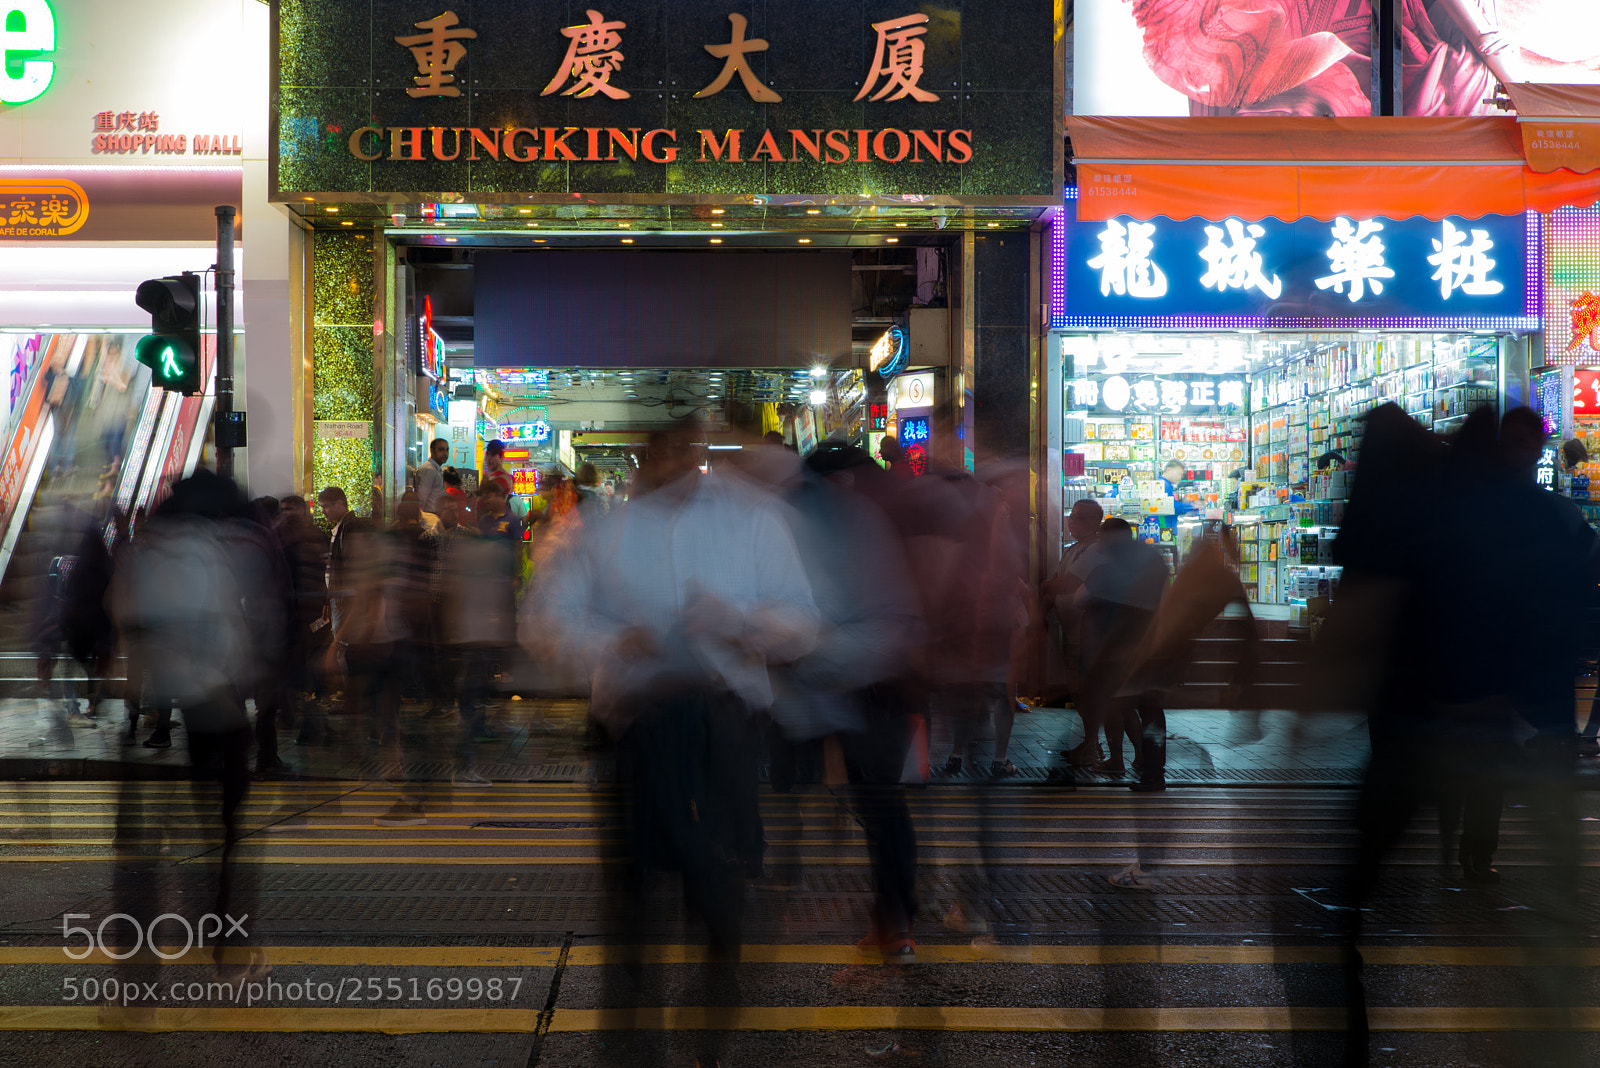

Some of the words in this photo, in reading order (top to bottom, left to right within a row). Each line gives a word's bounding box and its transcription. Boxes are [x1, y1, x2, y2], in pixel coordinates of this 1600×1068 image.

[97, 110, 159, 130] 重庆站
[95, 134, 187, 151] SHOPPING
[194, 134, 243, 151] MALL
[350, 126, 680, 163] CHUNGKING
[697, 127, 973, 163] MANSIONS
[1088, 186, 1137, 197] 61538444
[16, 227, 28, 236] DE
[29, 227, 58, 236] CORAL
[452, 426, 469, 469] 興行
[1537, 447, 1555, 491] 政府
